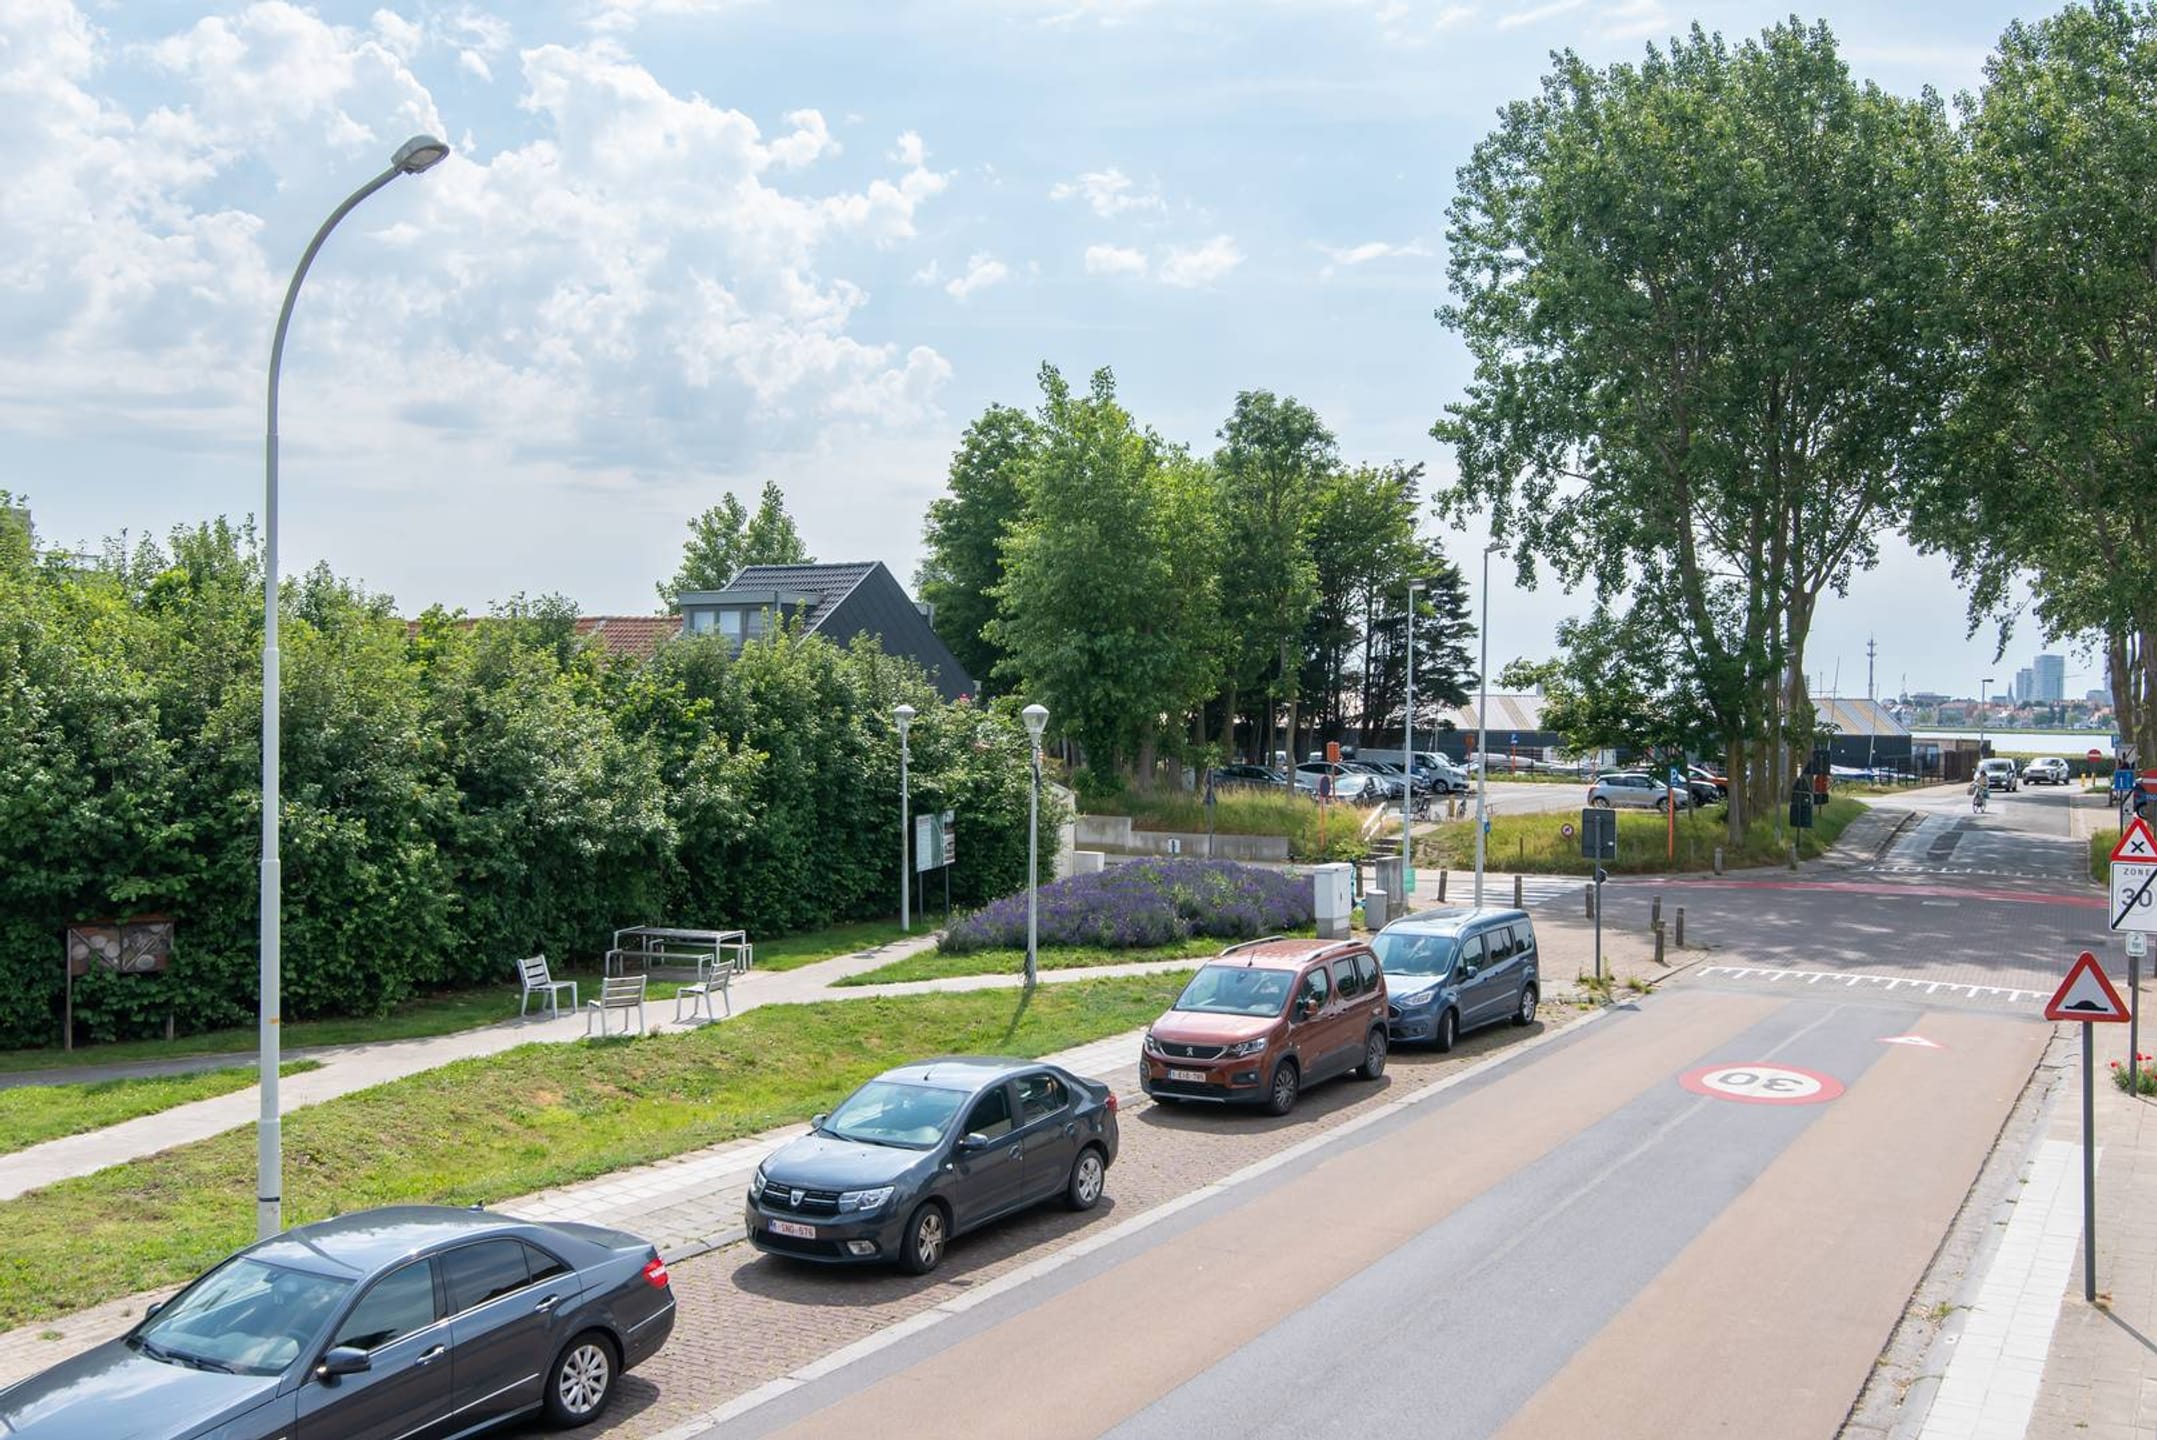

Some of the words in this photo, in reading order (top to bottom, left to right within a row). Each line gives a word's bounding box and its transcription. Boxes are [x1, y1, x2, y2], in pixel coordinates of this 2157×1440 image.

[1670, 768, 1678, 783] P
[2123, 868, 2151, 876] ZONE
[2121, 887, 2153, 907] 30
[1717, 1072, 1804, 1092] 30
